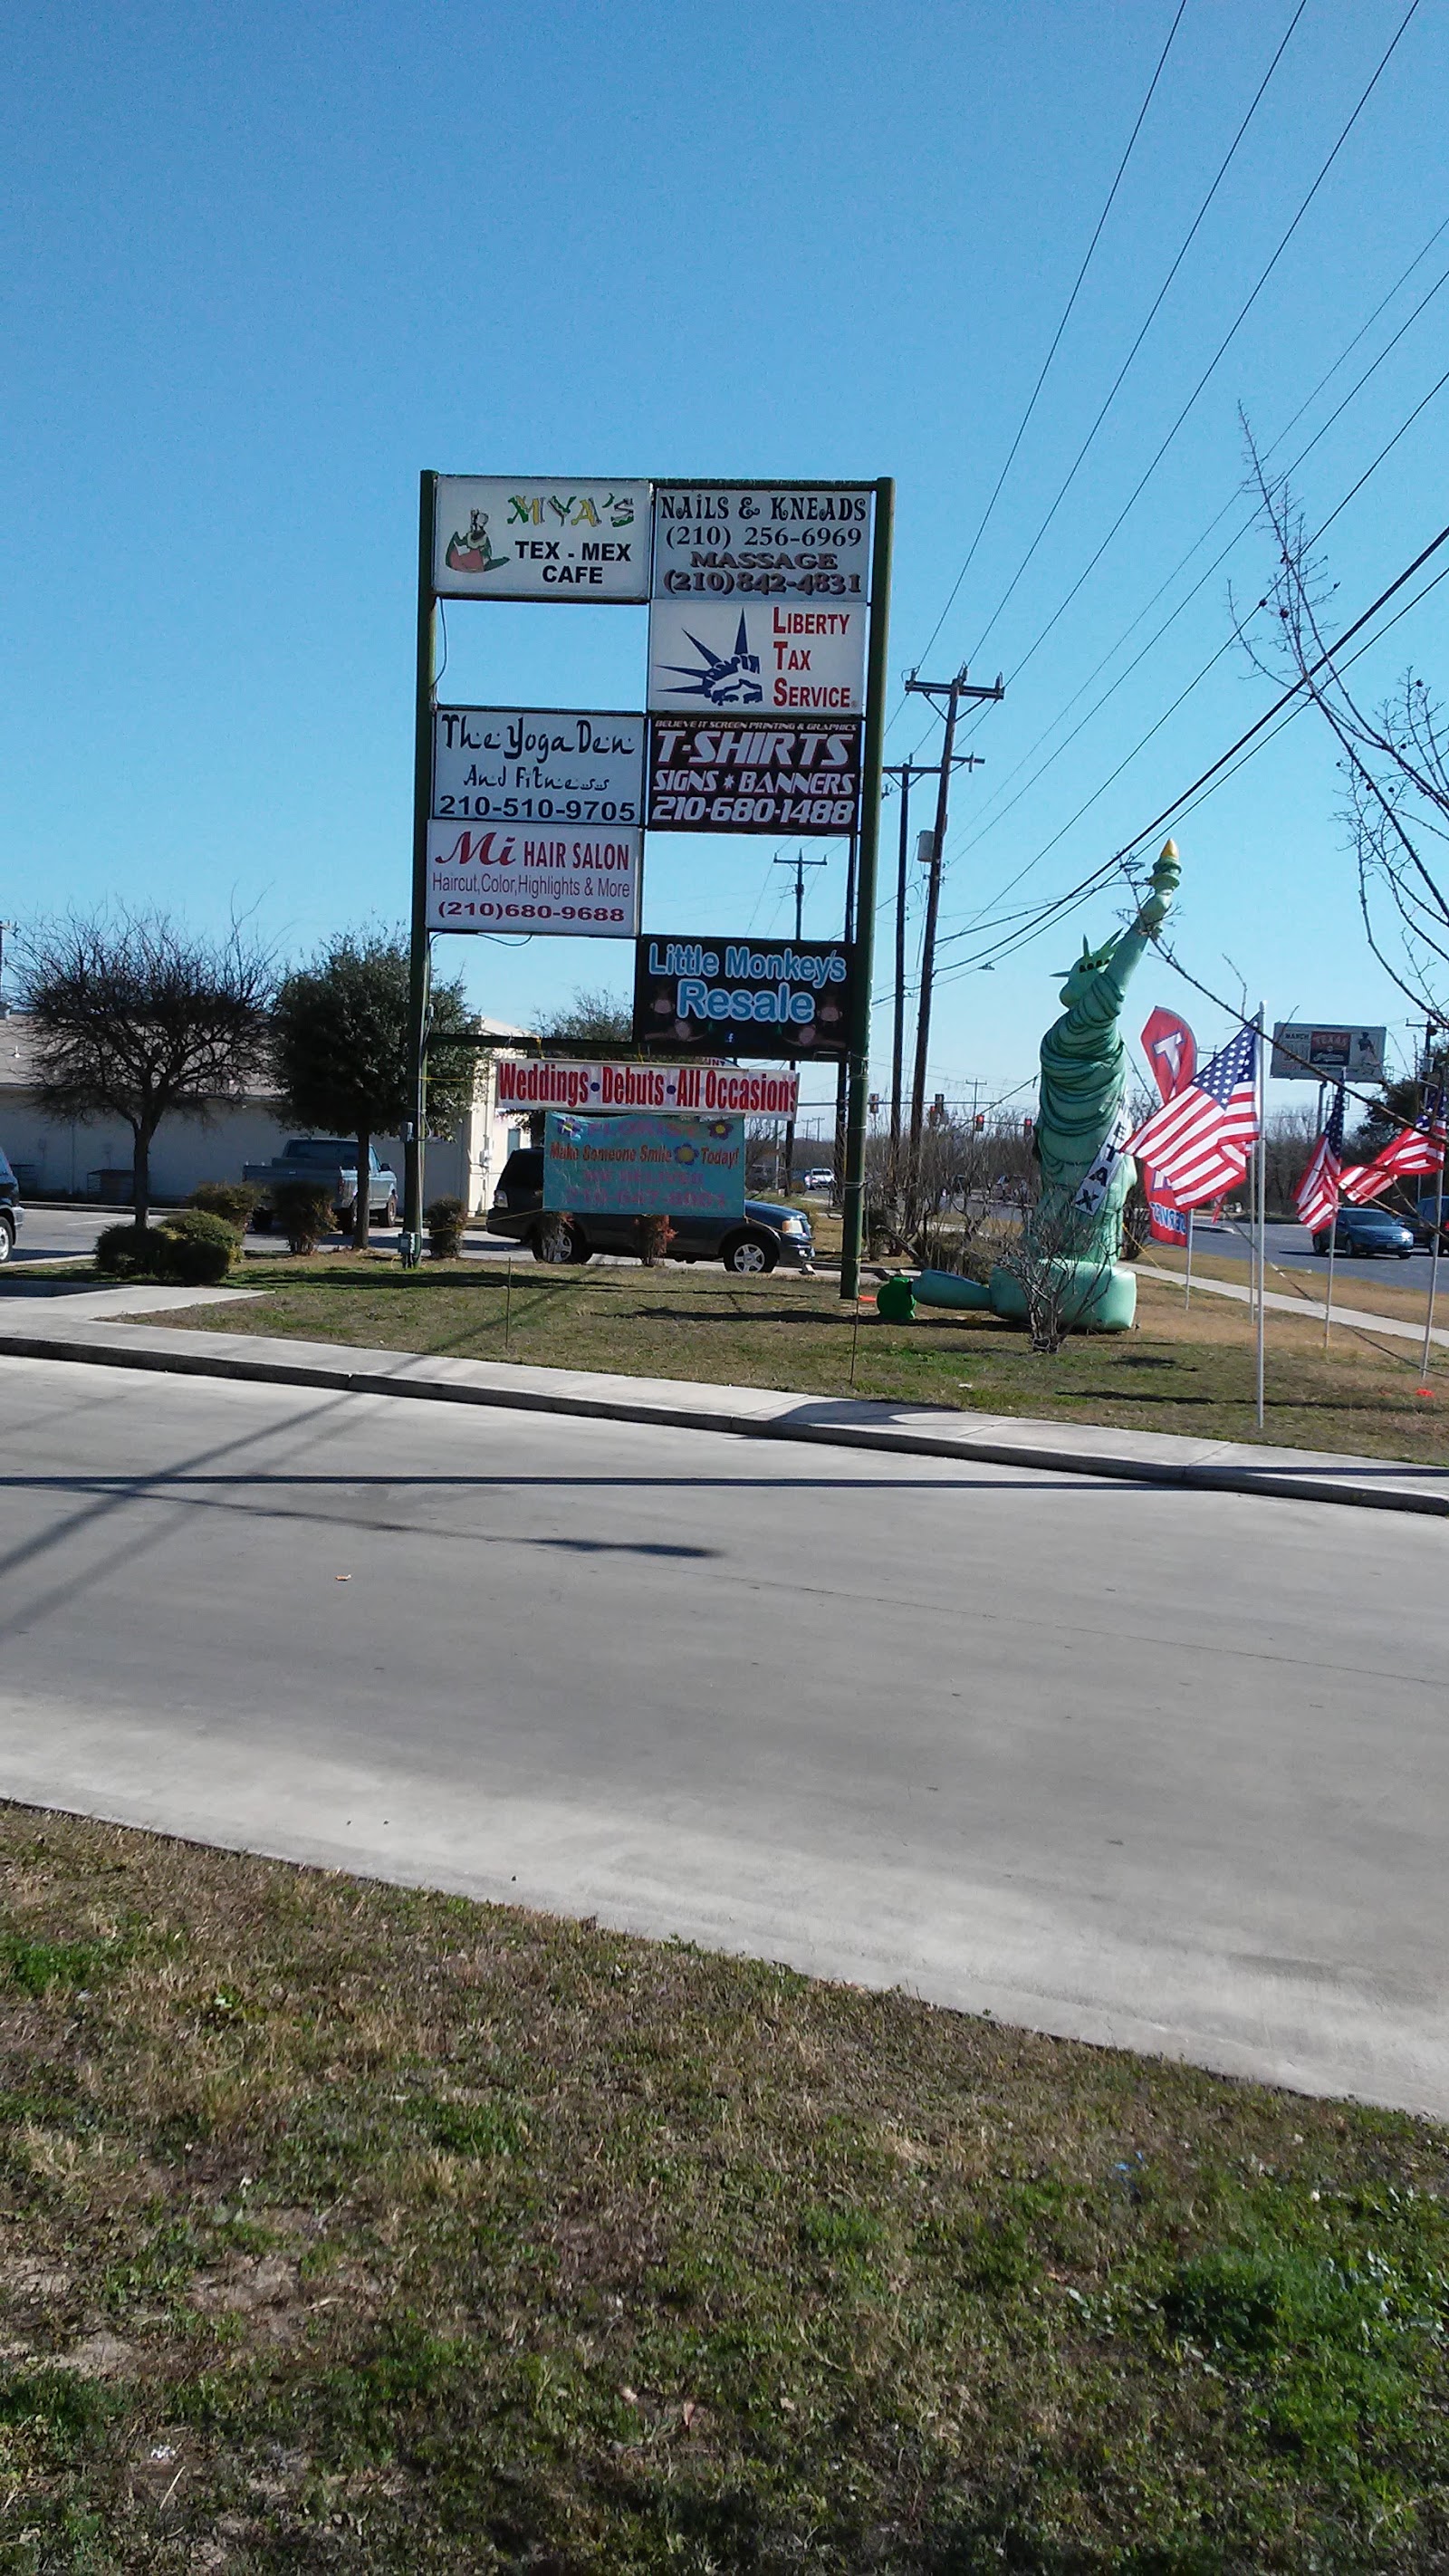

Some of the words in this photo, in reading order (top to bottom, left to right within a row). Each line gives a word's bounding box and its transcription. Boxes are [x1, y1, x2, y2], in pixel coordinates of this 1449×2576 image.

[507, 493, 634, 527] MYA'S
[739, 500, 761, 519] &
[771, 497, 867, 521] KNEADS
[666, 525, 731, 548] (210)
[744, 527, 862, 548] 256-6969
[514, 541, 561, 560] TEX
[581, 543, 631, 562] MEX
[690, 552, 838, 570] MASSAGE
[542, 565, 603, 584] CAFE
[772, 607, 849, 636] LIBERTY
[772, 641, 811, 670] TAX
[441, 714, 501, 750] The
[504, 717, 574, 763] Yoga
[577, 720, 635, 755] Den
[697, 720, 706, 728] IT
[709, 721, 747, 729] SCREEN
[749, 722, 795, 730] PRINTING
[657, 730, 855, 766] T-SHIRTS
[463, 764, 506, 788] And
[514, 766, 609, 791] Fitness
[653, 769, 719, 792] SIGNS
[738, 771, 855, 795] BANNERS
[439, 795, 635, 822] 210-510-9705
[652, 796, 855, 824] 210-680-1488
[435, 831, 516, 866] Mi
[523, 841, 566, 869] HAIR
[572, 842, 629, 870] SALON
[584, 876, 594, 895] &
[598, 877, 629, 898] More
[437, 901, 625, 922] (210)680-9688
[648, 942, 720, 976] Little
[724, 946, 847, 989] Monkey's
[677, 978, 815, 1024] Resale
[499, 1062, 589, 1107] Weddings
[601, 1067, 664, 1106] Debuts
[677, 1069, 700, 1108] All
[705, 1071, 797, 1112] Occasions
[550, 1142, 579, 1160] Make
[583, 1145, 636, 1162] Someone
[639, 1145, 672, 1163] Smile
[701, 1148, 740, 1169] Today!
